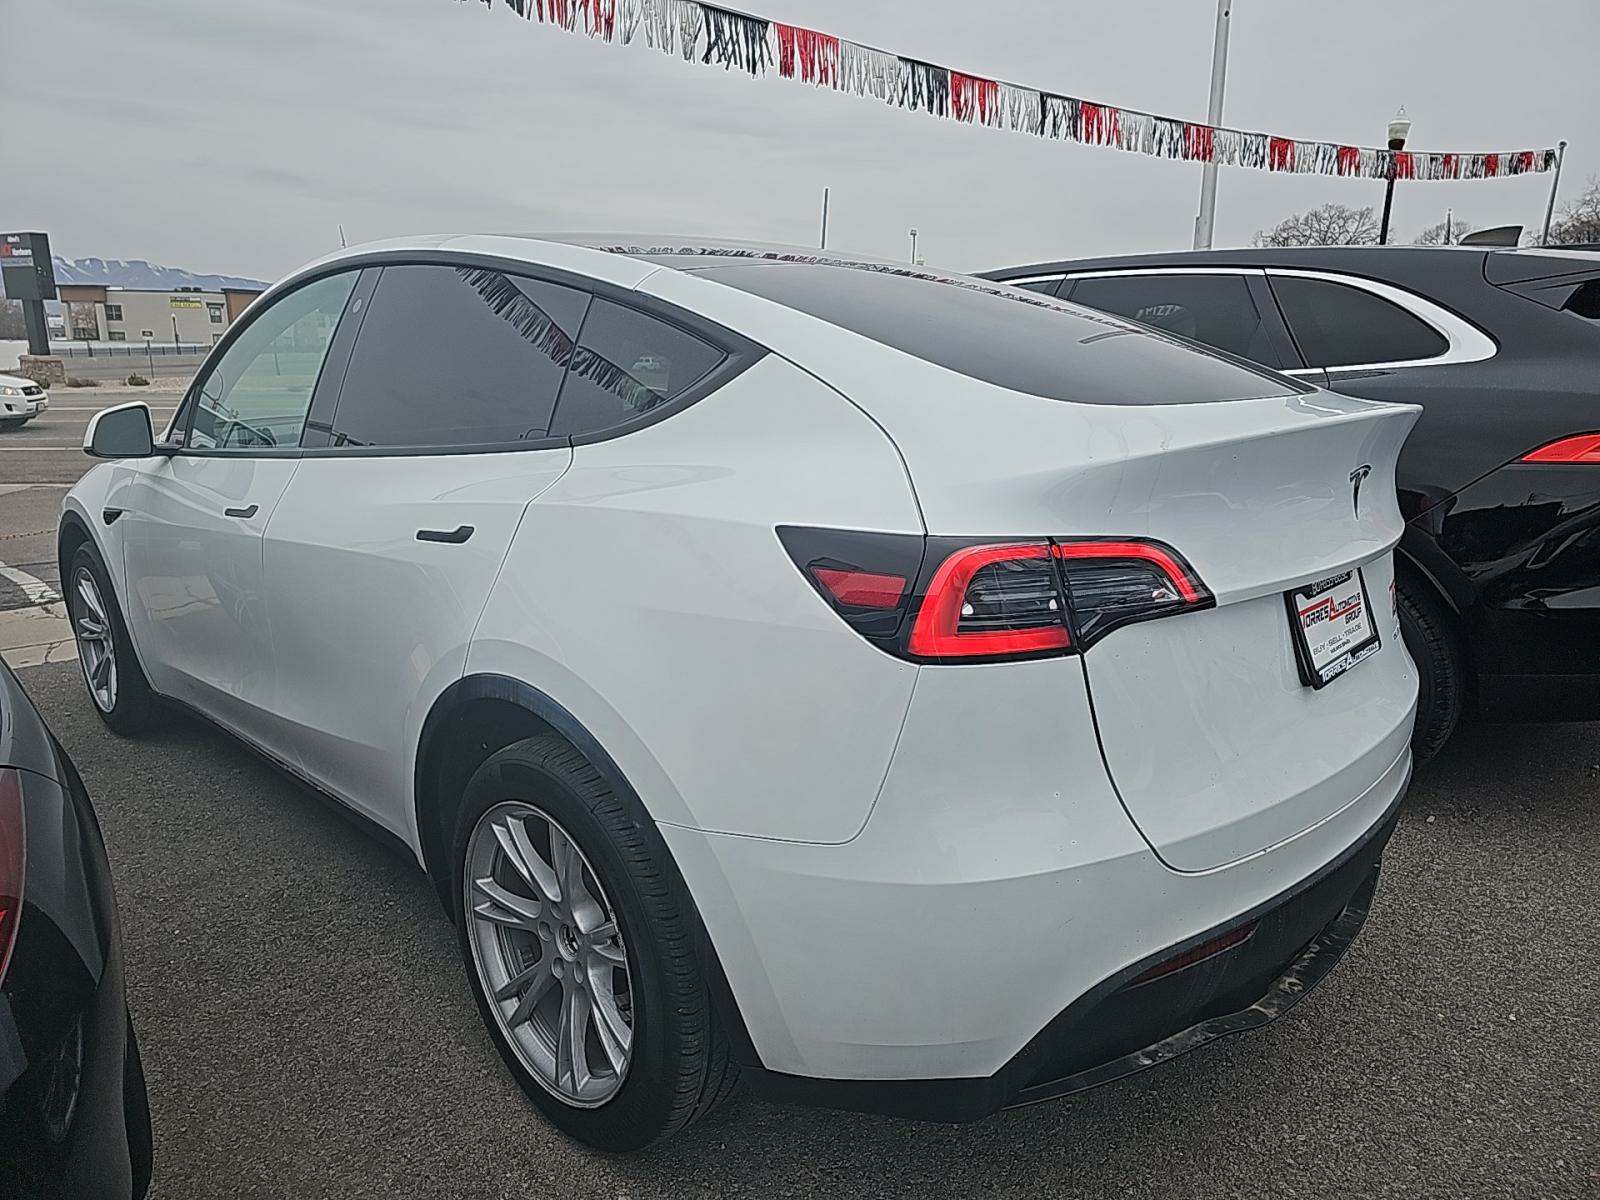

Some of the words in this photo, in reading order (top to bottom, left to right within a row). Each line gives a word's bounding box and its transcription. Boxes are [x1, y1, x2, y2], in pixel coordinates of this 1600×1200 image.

[1298, 600, 1330, 630] TORRES
[1344, 606, 1362, 625] GROUP
[1313, 642, 1326, 656] BUY
[1344, 622, 1362, 636] TRADE
[1319, 654, 1347, 683] TORRES
